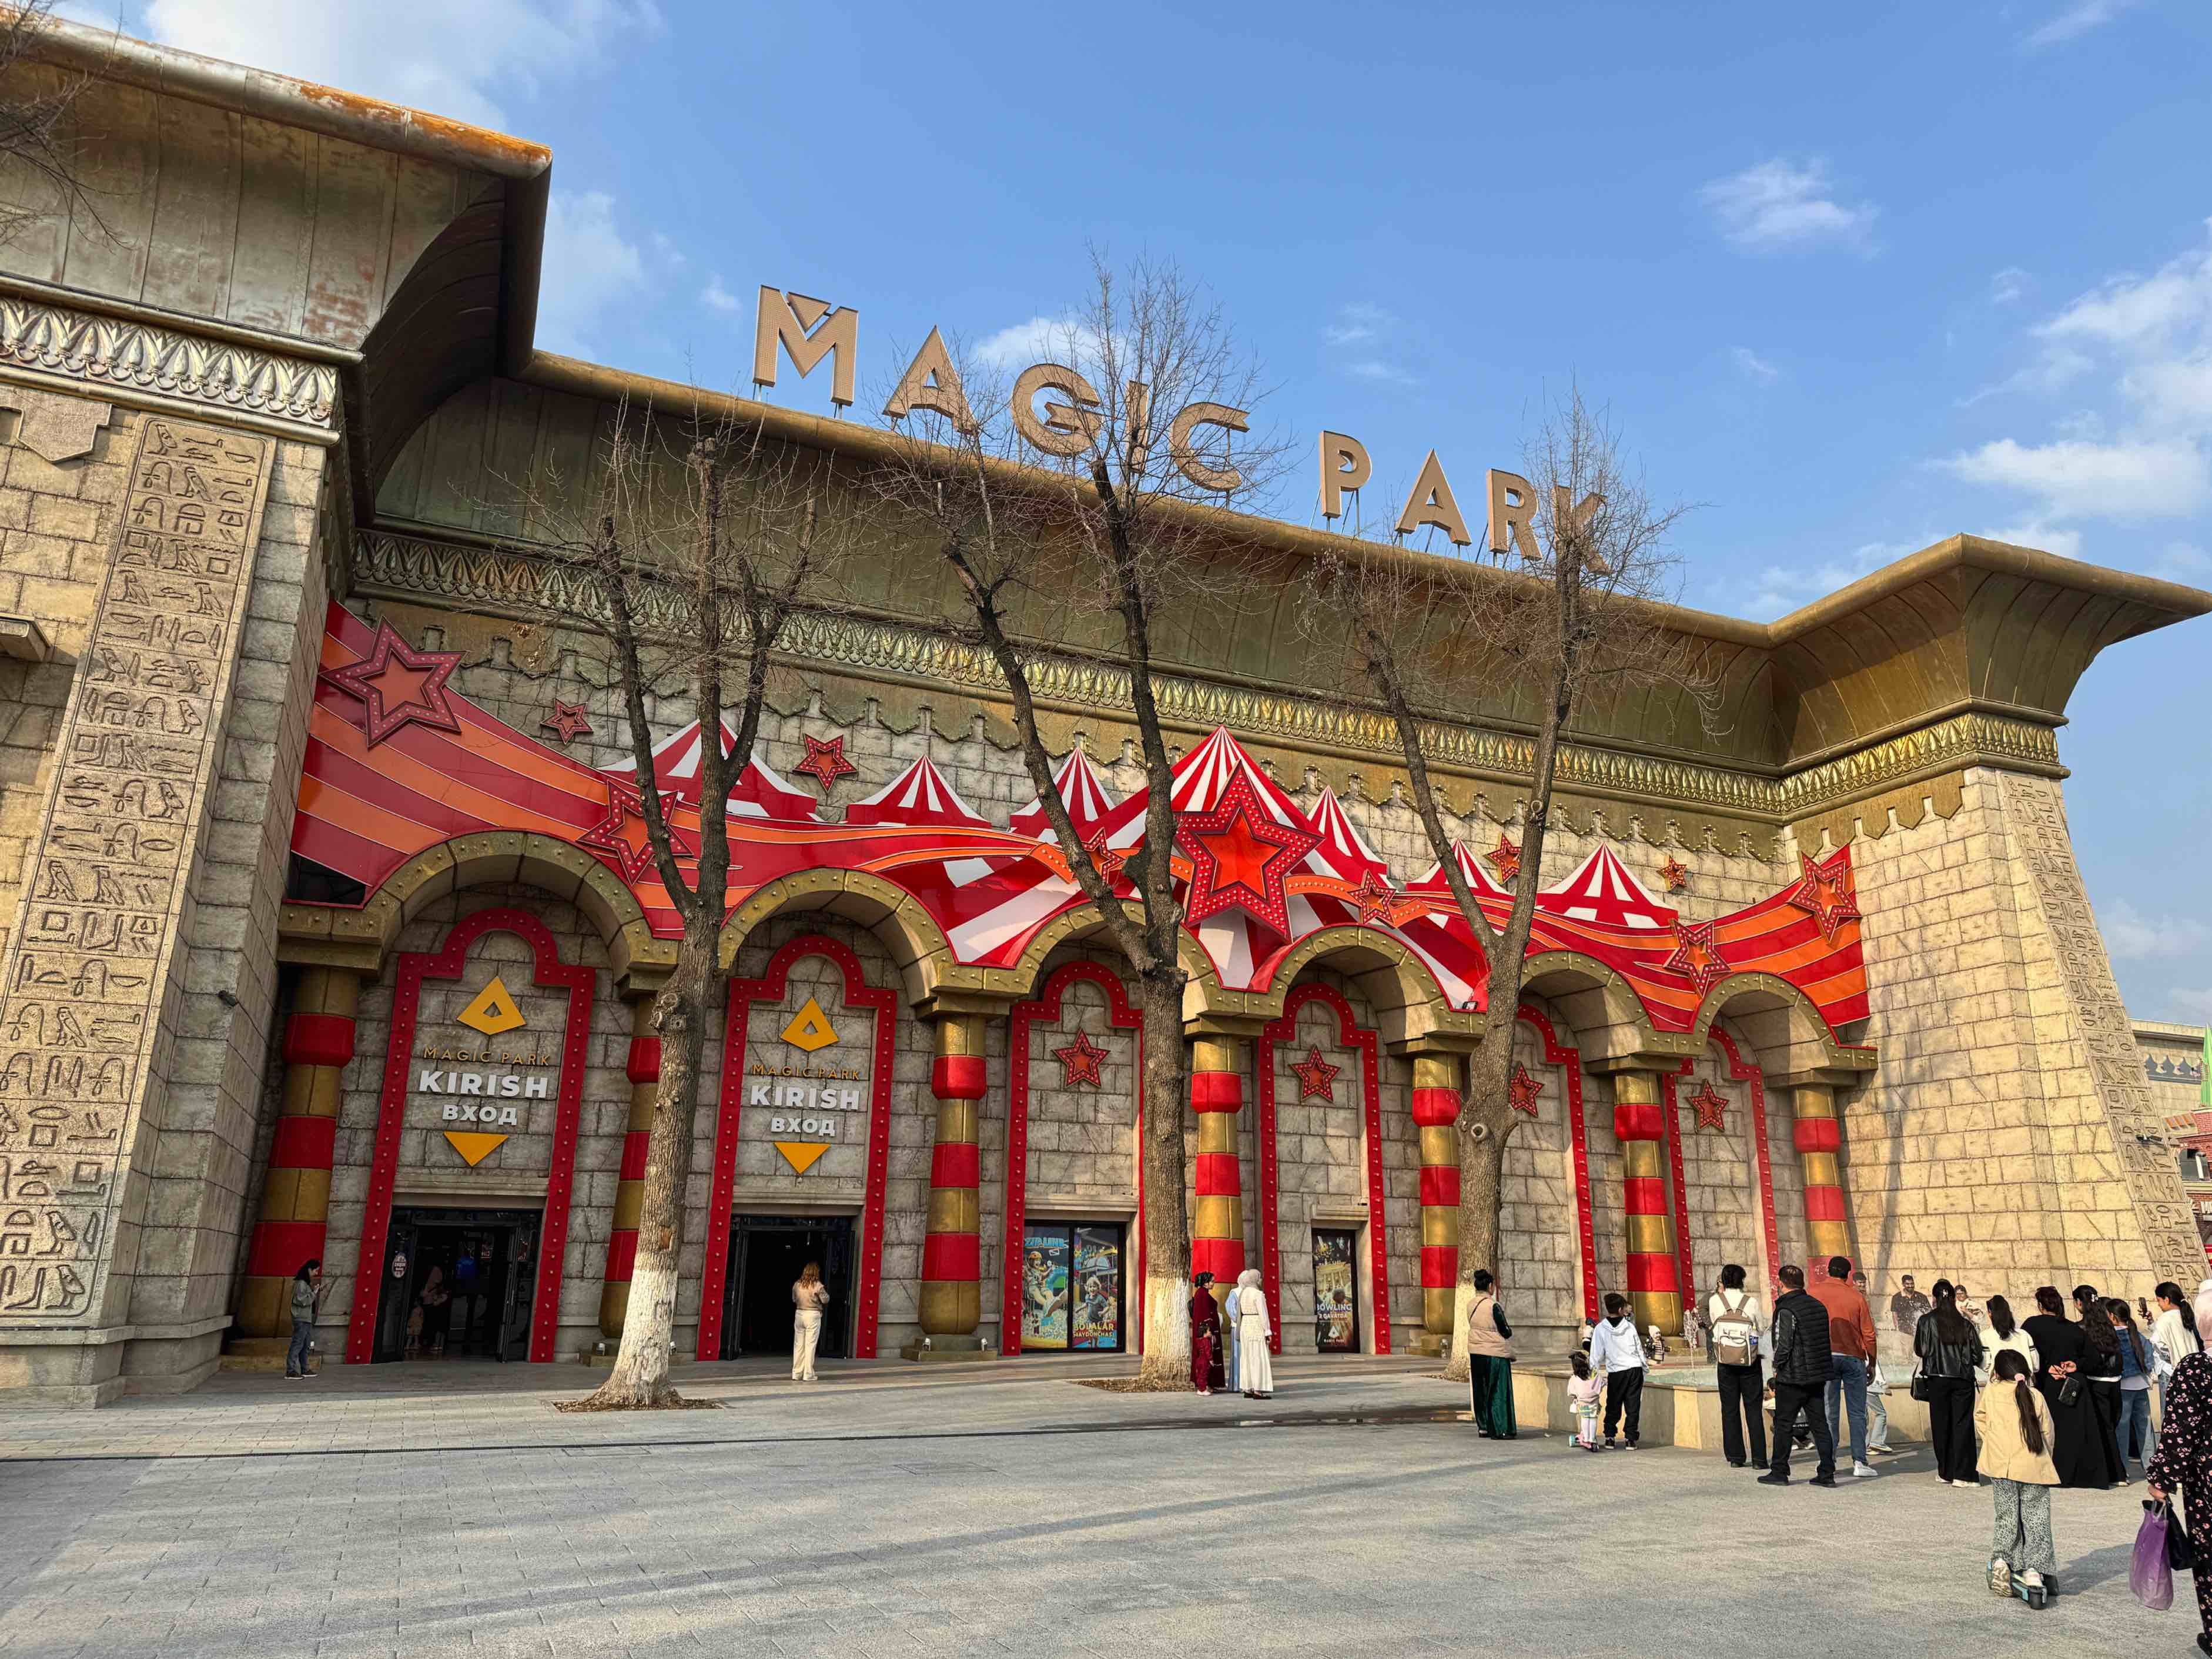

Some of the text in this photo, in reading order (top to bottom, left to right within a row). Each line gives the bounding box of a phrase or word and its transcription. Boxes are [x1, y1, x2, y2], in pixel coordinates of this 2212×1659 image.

[754, 284, 1613, 576] MAGIC PARK
[424, 1048, 550, 1066] MAGIC PARK
[752, 1065, 860, 1081] MAGIC PARK
[419, 1071, 548, 1098] KIRISH
[750, 1085, 860, 1110] KIRISH
[442, 1105, 517, 1126] ВХОД
[771, 1117, 835, 1137] ВХОД
